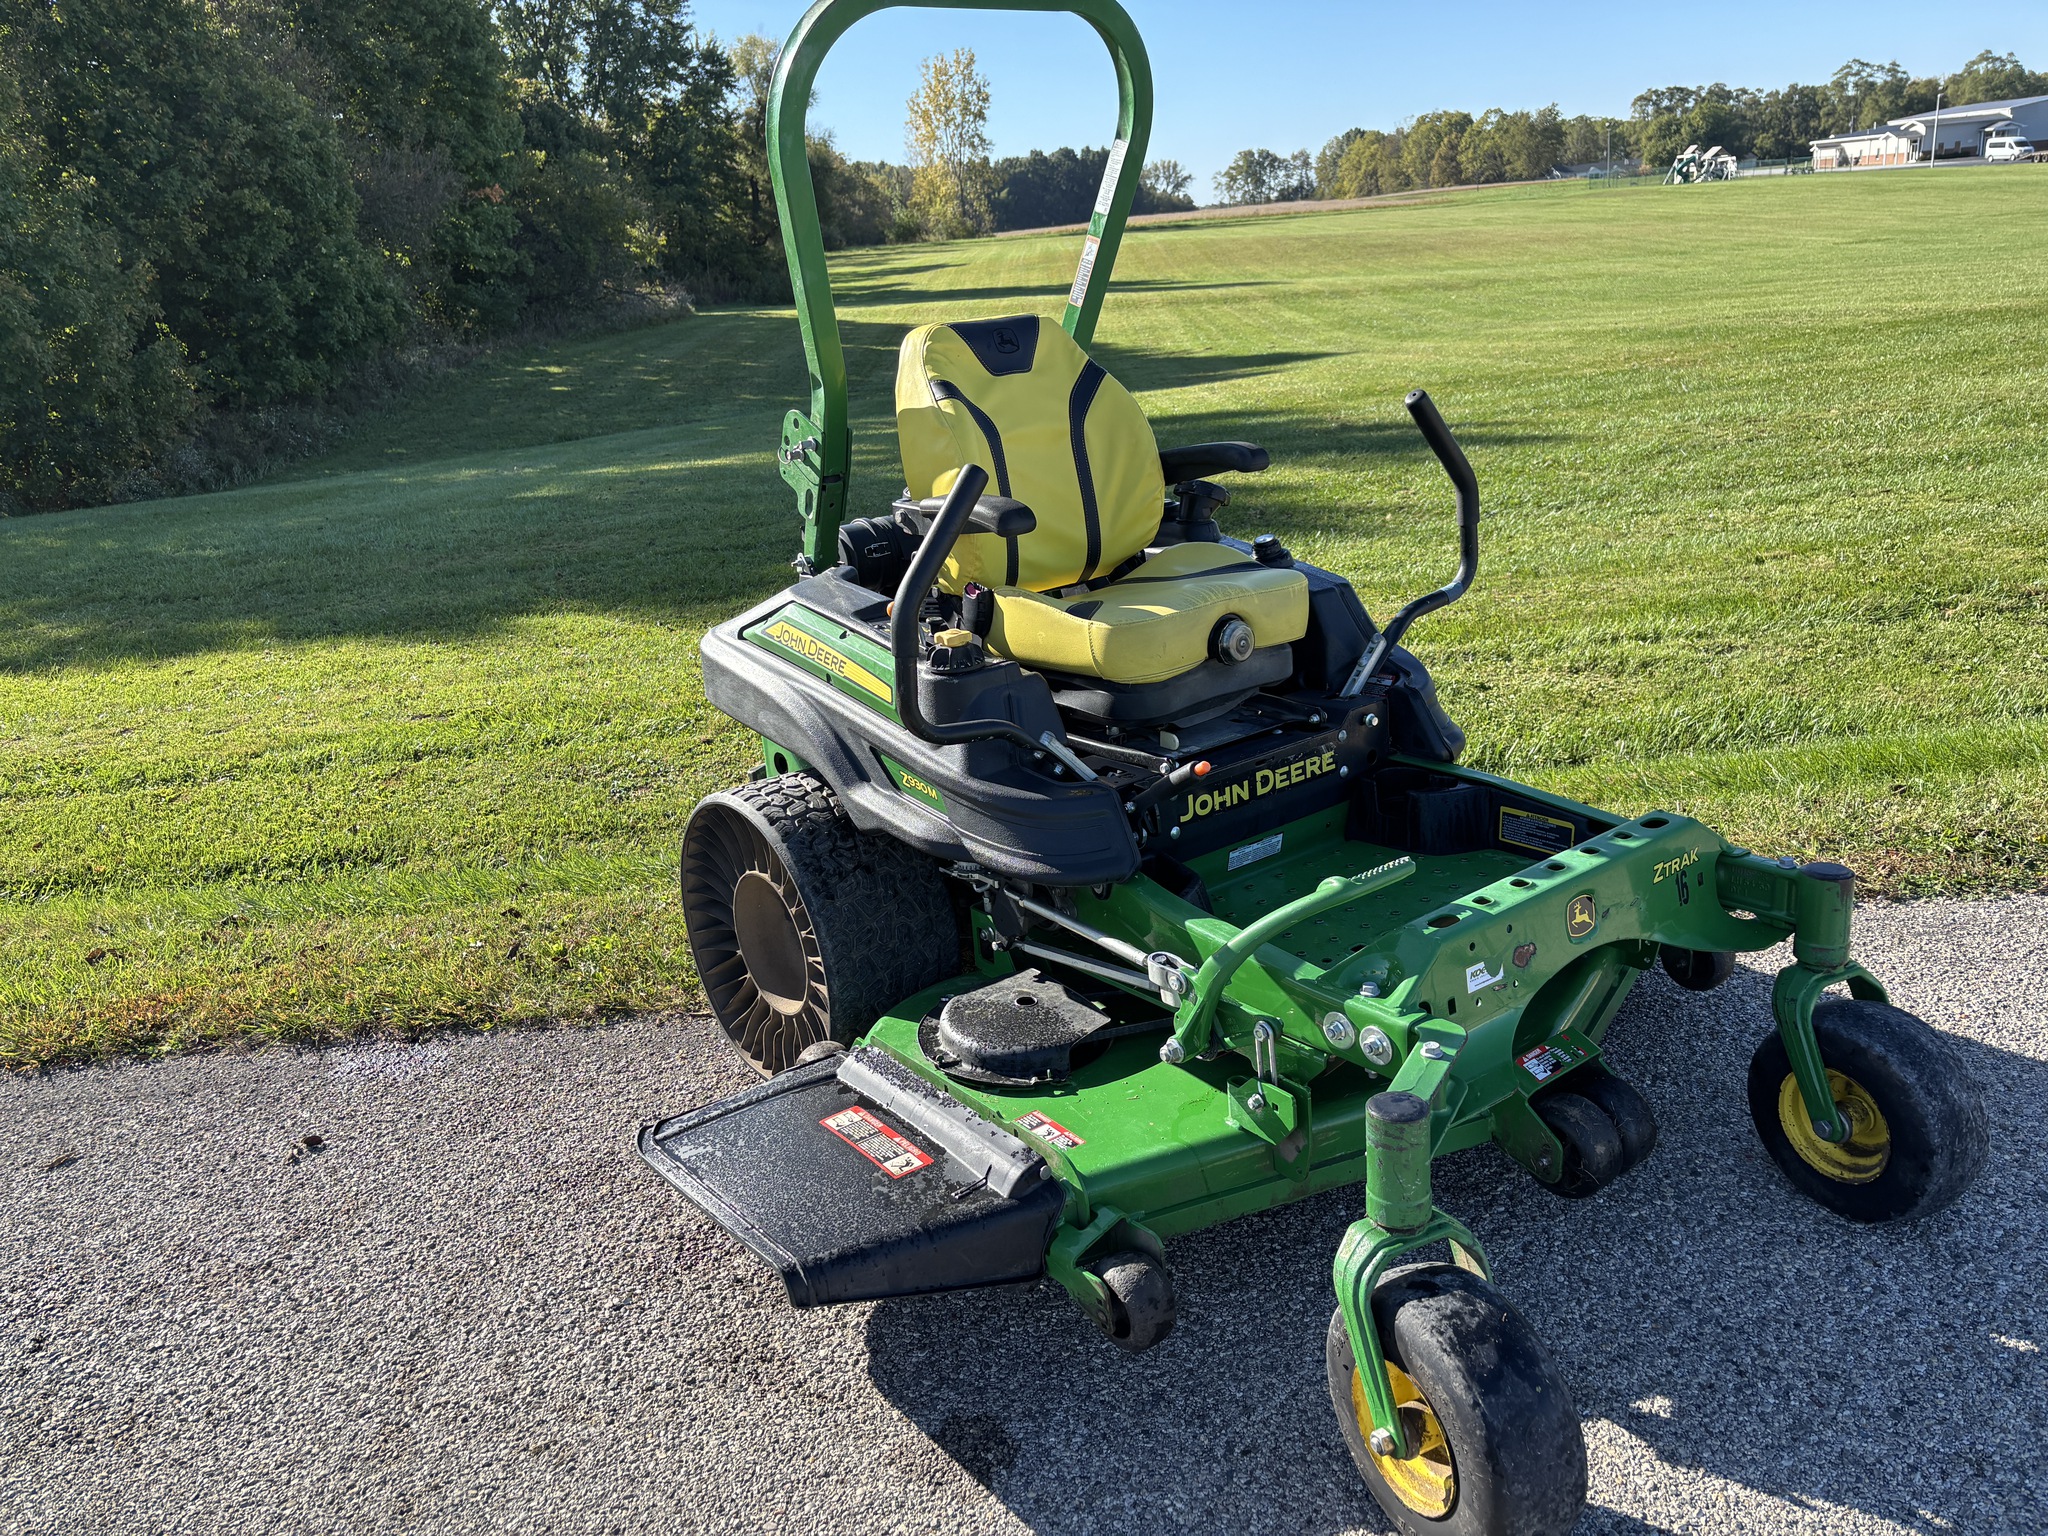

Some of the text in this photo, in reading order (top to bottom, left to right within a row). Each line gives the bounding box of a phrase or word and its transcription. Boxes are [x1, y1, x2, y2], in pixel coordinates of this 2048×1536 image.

[776, 625, 847, 675] JOHN DEERE
[900, 770, 938, 801] Z930M
[1180, 751, 1336, 823] JOHN DEERE
[1653, 846, 1699, 885] ZTRAK
[1675, 869, 1690, 907] 16
